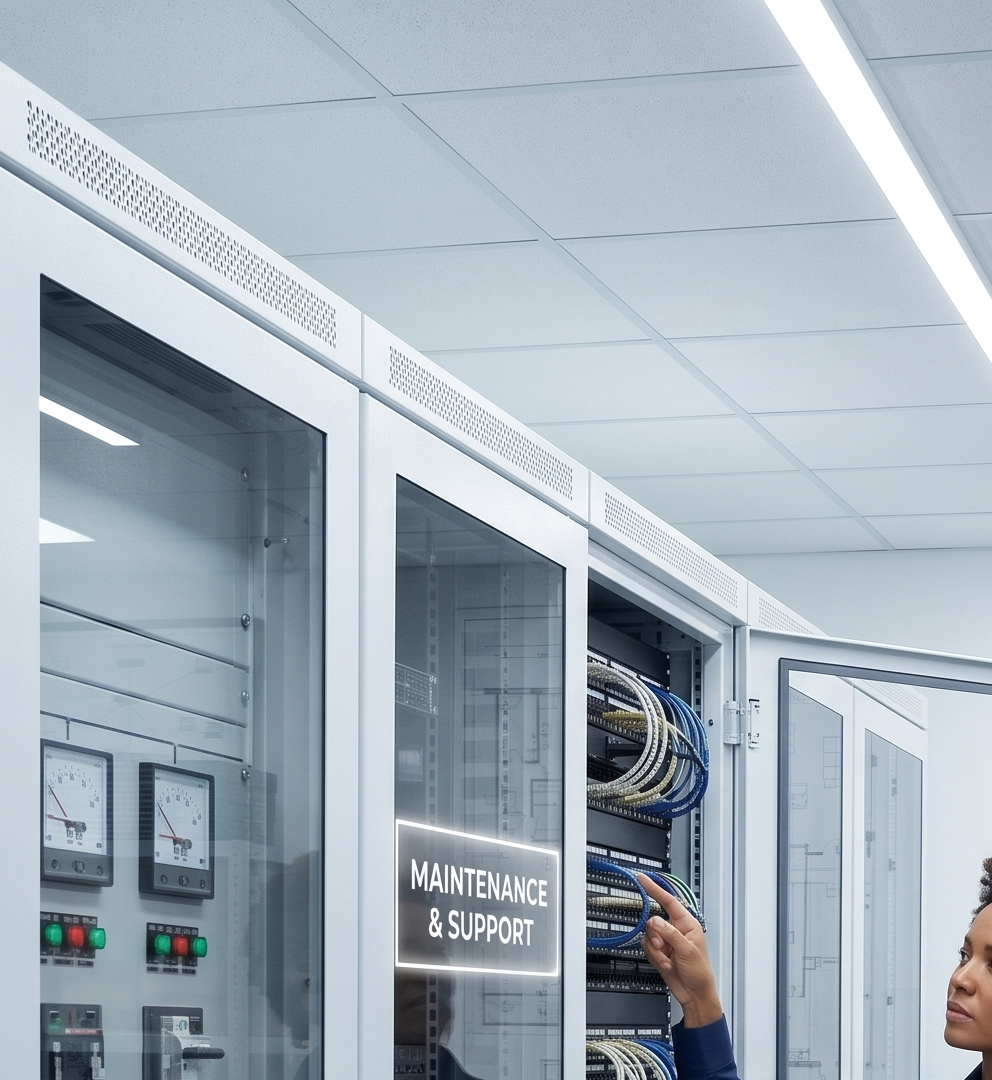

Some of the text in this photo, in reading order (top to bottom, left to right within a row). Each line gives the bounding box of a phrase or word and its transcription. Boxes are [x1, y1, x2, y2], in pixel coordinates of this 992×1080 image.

[411, 858, 548, 907] MAINTENANCE
[428, 907, 534, 946] & SUPPORT
